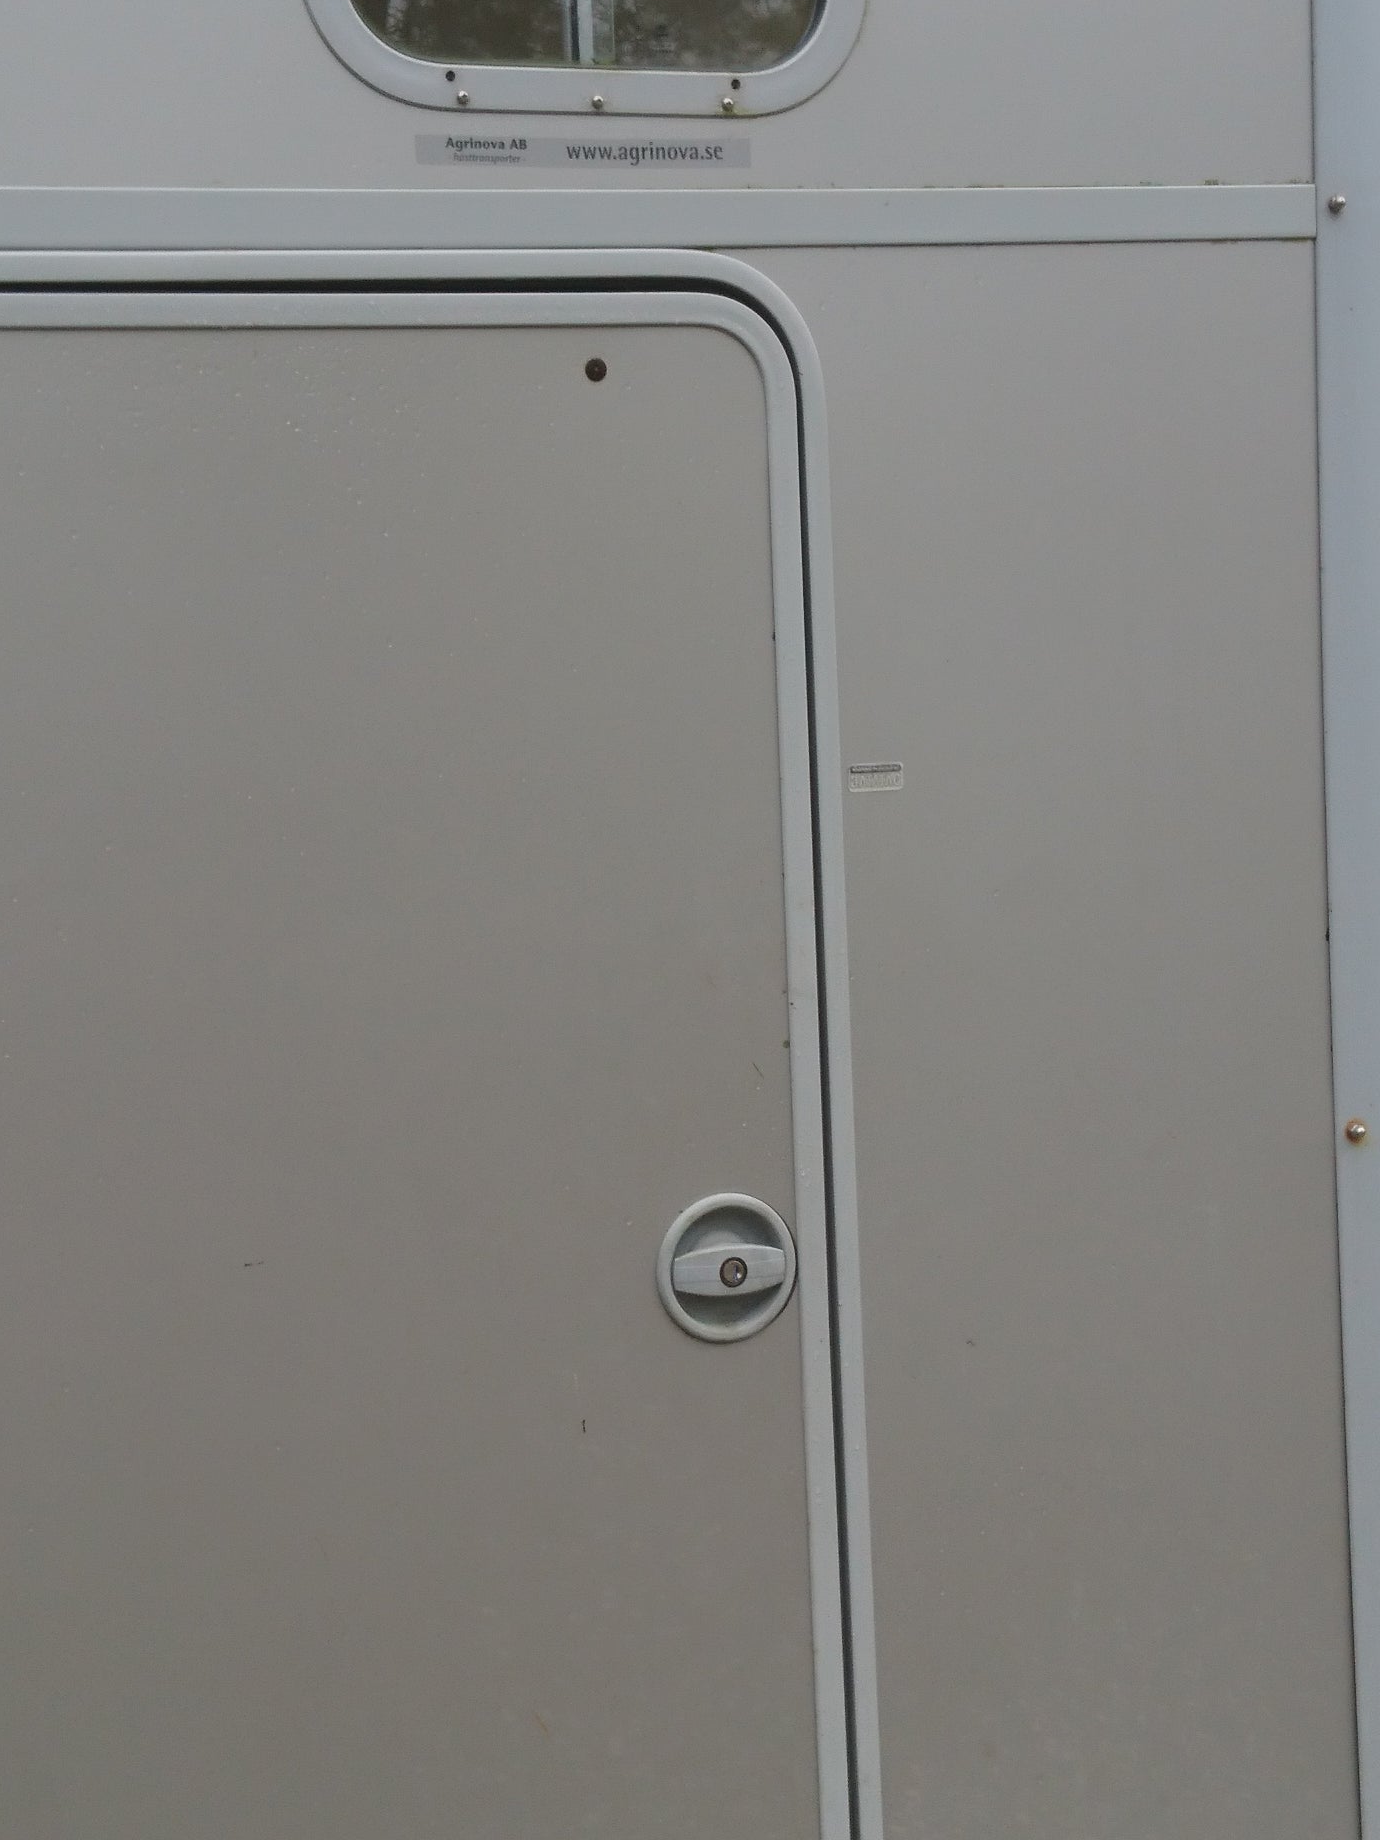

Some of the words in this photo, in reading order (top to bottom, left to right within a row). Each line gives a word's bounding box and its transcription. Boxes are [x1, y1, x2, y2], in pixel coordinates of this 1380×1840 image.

[445, 137, 505, 152] Agrinova
[509, 138, 528, 150] AB
[566, 141, 724, 166] www.agrinova.se
